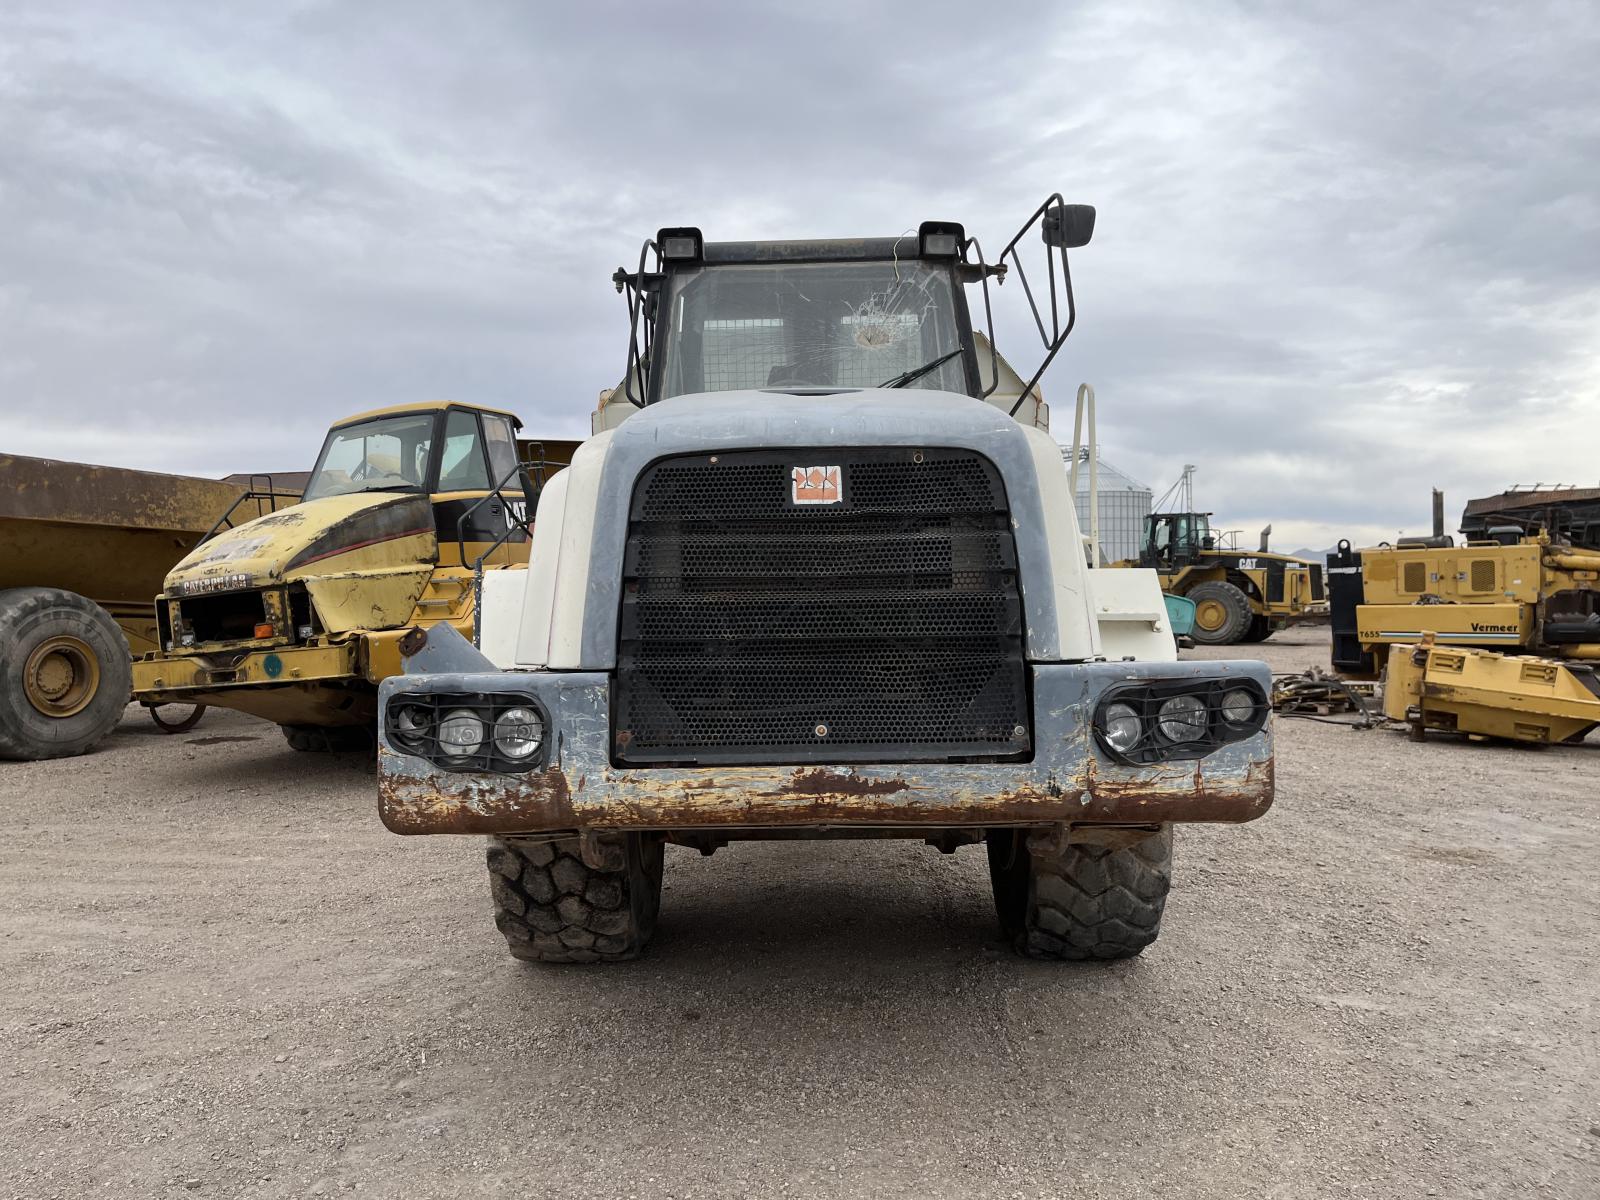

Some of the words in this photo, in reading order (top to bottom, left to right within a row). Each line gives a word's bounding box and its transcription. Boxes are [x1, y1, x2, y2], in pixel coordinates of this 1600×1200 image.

[504, 501, 528, 530] CAT
[1239, 563, 1258, 575] CAT
[1471, 623, 1518, 632] Vermeer
[1359, 631, 1380, 639] T655
